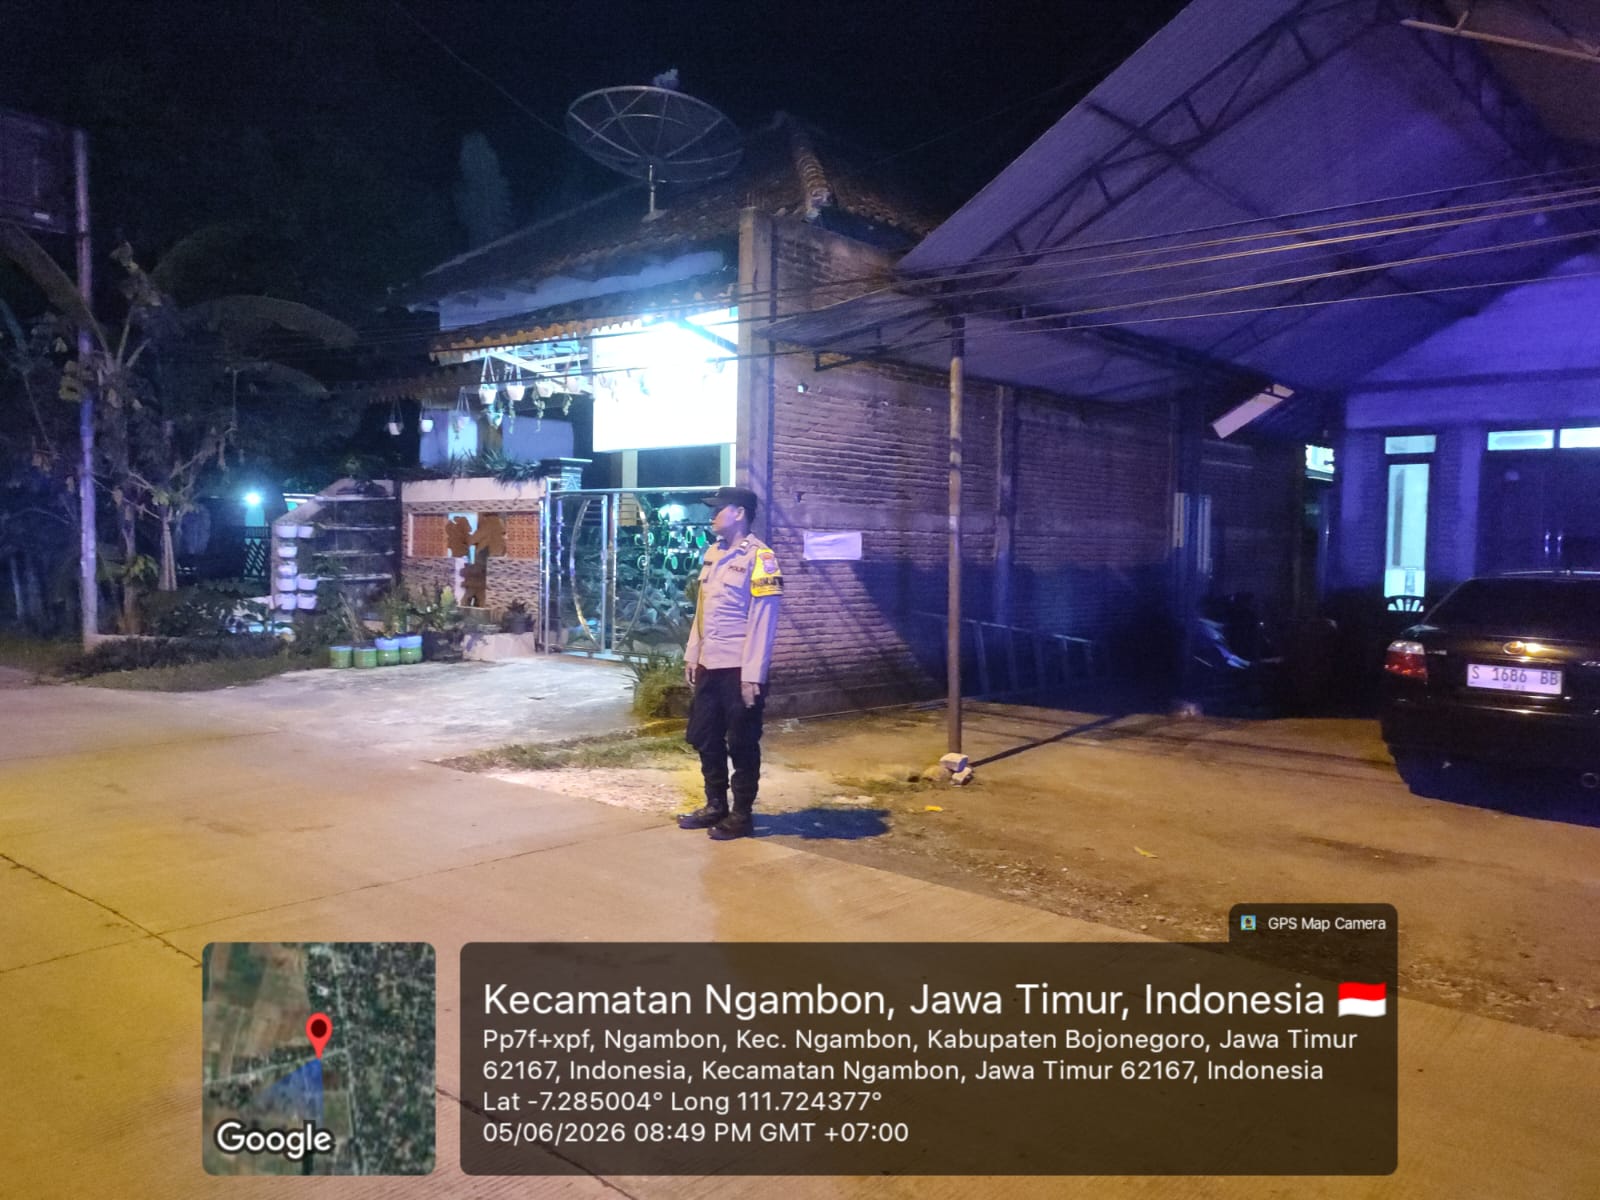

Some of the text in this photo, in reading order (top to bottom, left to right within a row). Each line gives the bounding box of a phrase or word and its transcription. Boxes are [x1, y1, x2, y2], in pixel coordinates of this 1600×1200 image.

[1471, 665, 1559, 686] S 1686 BB
